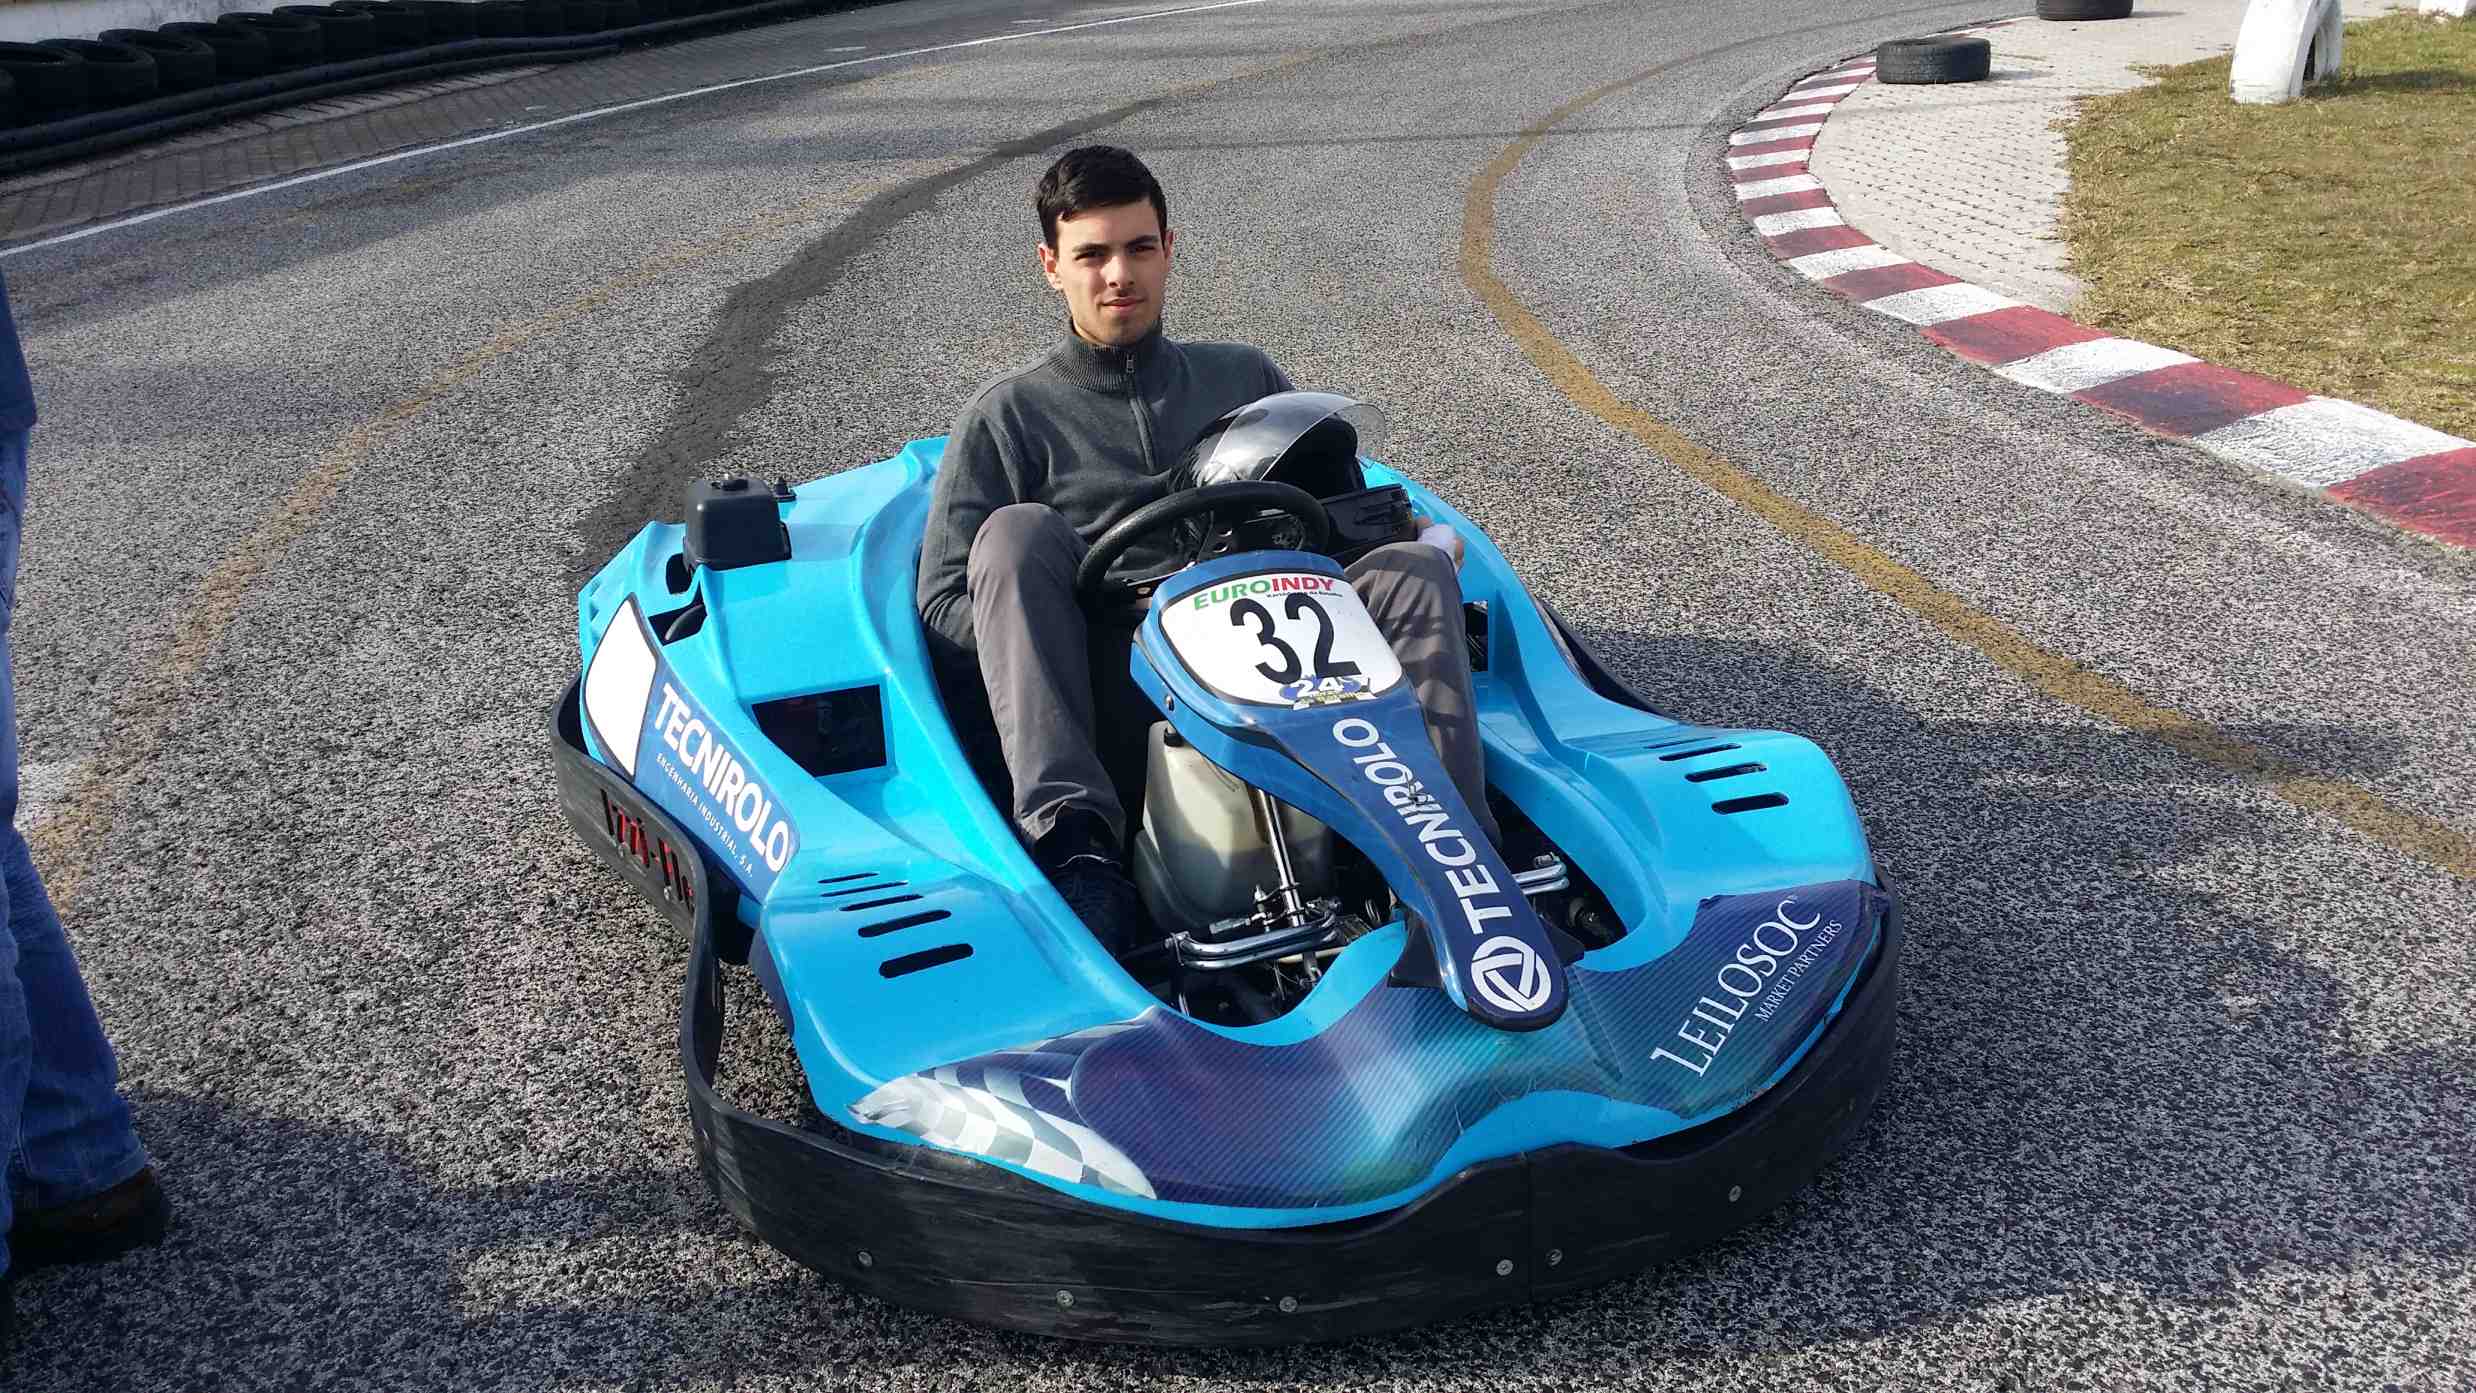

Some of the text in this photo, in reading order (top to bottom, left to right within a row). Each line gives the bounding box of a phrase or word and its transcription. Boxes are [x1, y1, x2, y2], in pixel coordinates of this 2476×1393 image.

[1193, 575, 1334, 610] EUROINDY
[1230, 592, 1362, 685] 32
[653, 682, 790, 873] TECNIROLO
[1332, 717, 1513, 935] TECNIROLO
[1649, 898, 1821, 1078] LEILOSOC
[1753, 918, 1843, 1023] MARKET PARTNERS
